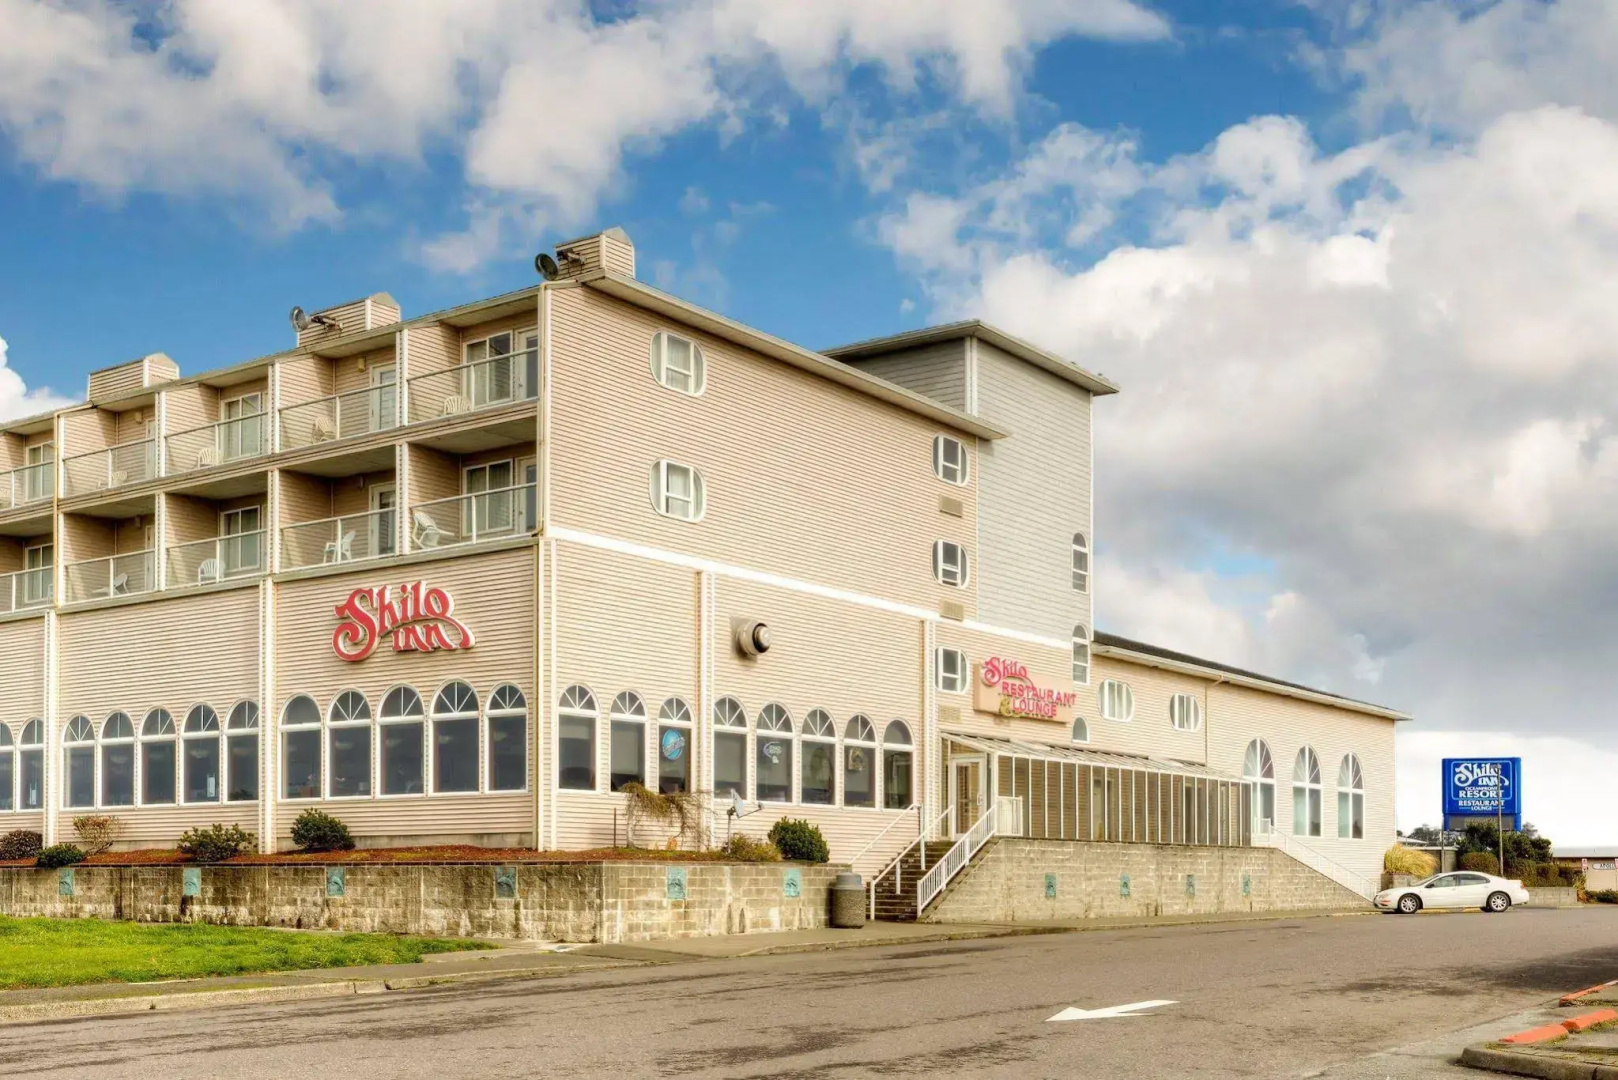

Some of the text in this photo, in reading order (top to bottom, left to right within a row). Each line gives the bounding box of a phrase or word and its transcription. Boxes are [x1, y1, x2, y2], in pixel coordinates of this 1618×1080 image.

[333, 581, 476, 662] Shilo
[984, 657, 1034, 685] Shilo
[1001, 681, 1076, 705] RESTAURANT
[1012, 698, 1057, 716] LOUNGE
[1459, 790, 1504, 798] RESORT
